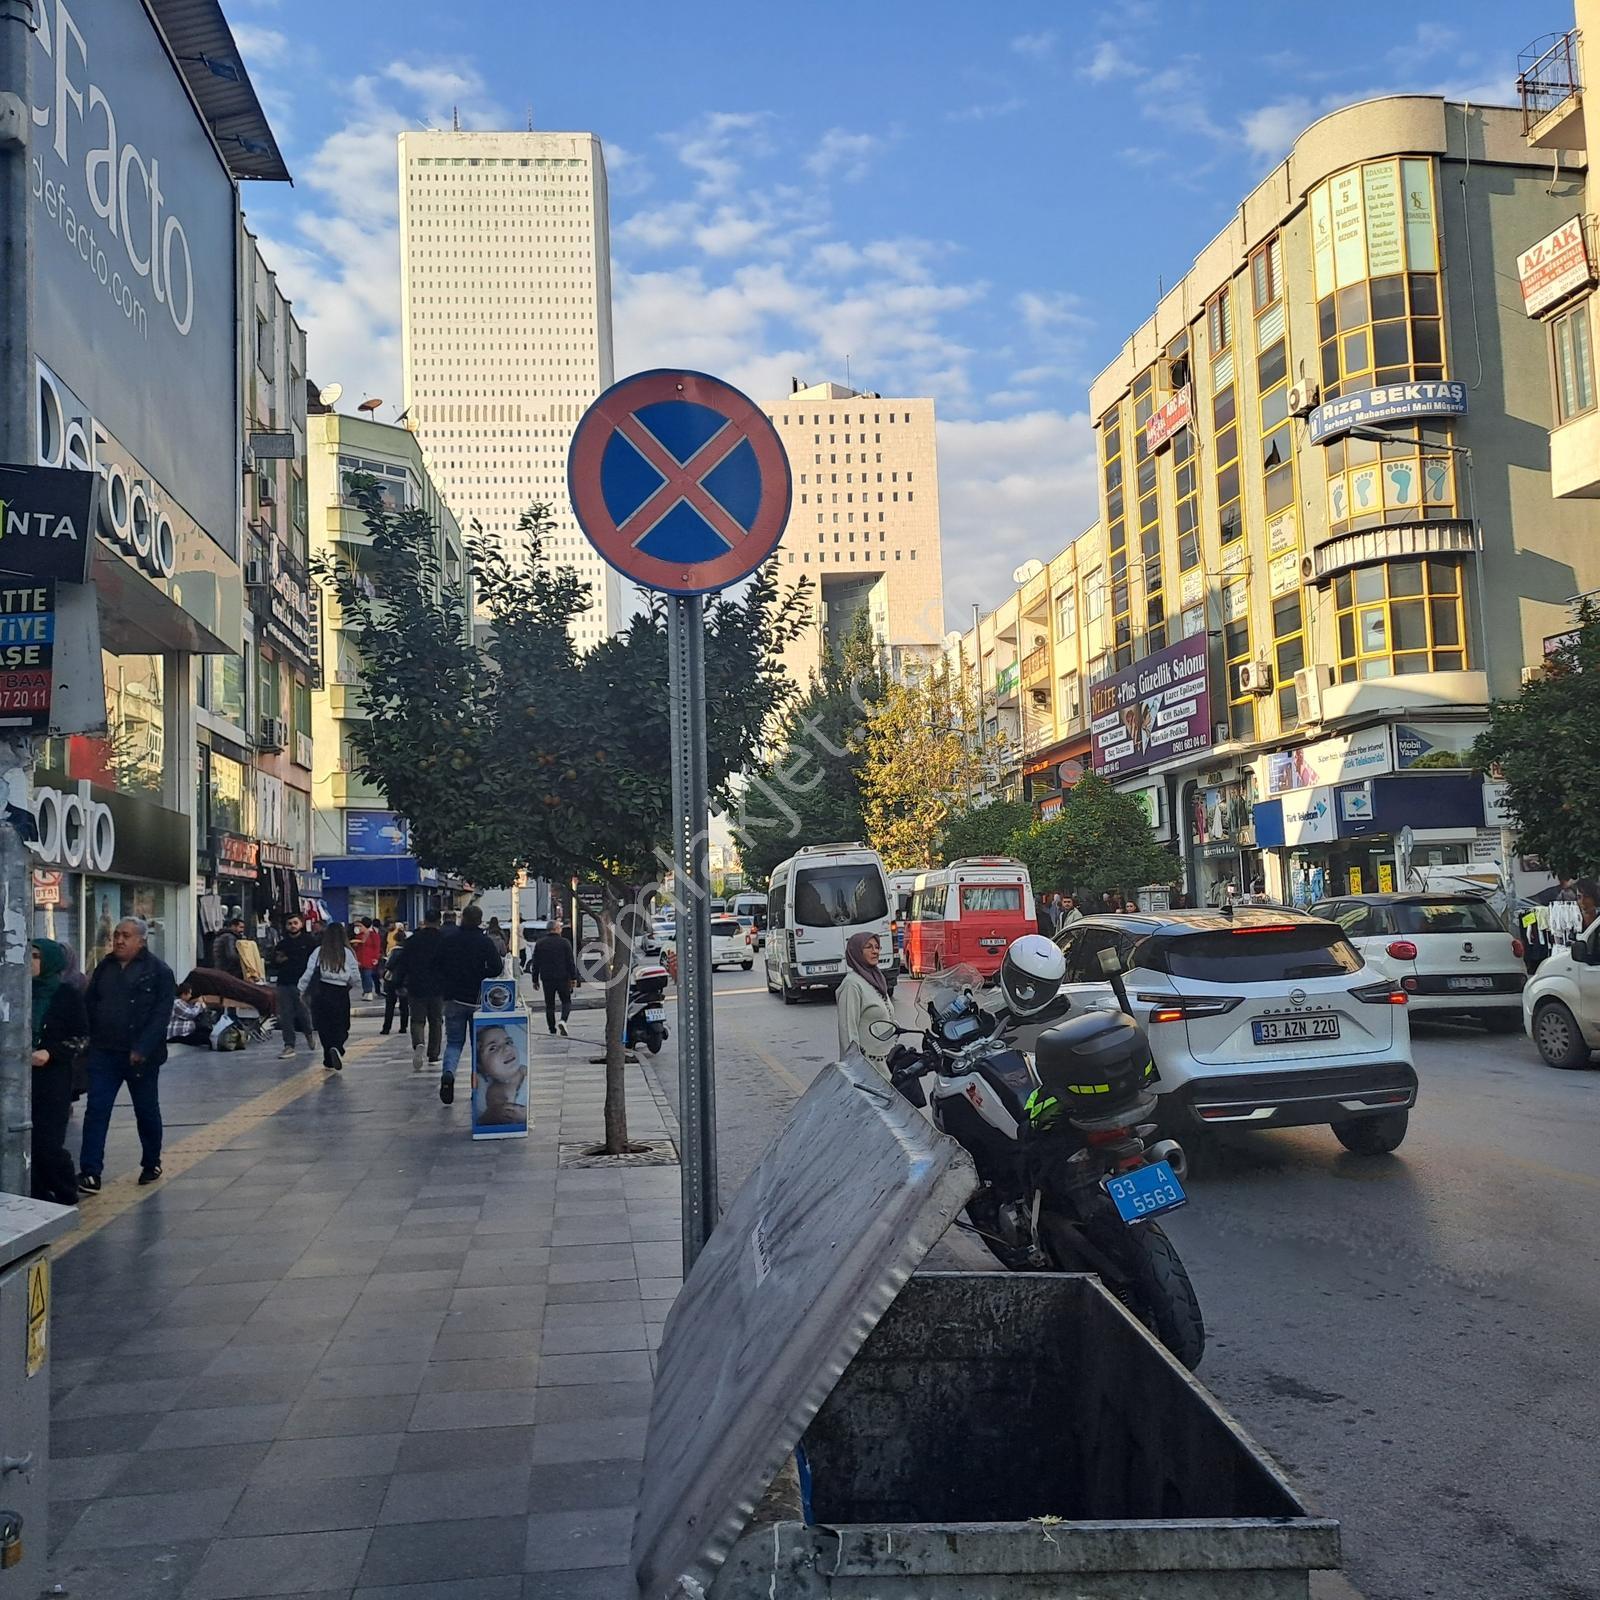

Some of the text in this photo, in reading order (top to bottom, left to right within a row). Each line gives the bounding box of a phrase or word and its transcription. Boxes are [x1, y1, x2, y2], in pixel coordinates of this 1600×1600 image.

[1342, 191, 1350, 203] 5
[1523, 222, 1579, 275] AZ-AK
[1370, 384, 1463, 406] BEKTAŞ
[1412, 400, 1432, 411] Mali
[1138, 662, 1172, 695] Güzellik
[1172, 653, 1205, 681] Salonu
[13, 690, 29, 708] 20
[31, 690, 46, 708] 11
[1399, 741, 1422, 749] Mobil
[1262, 1018, 1337, 1038] 33 AZN 220
[1112, 1167, 1167, 1199] 33 A
[1133, 1185, 1179, 1213] 5563
